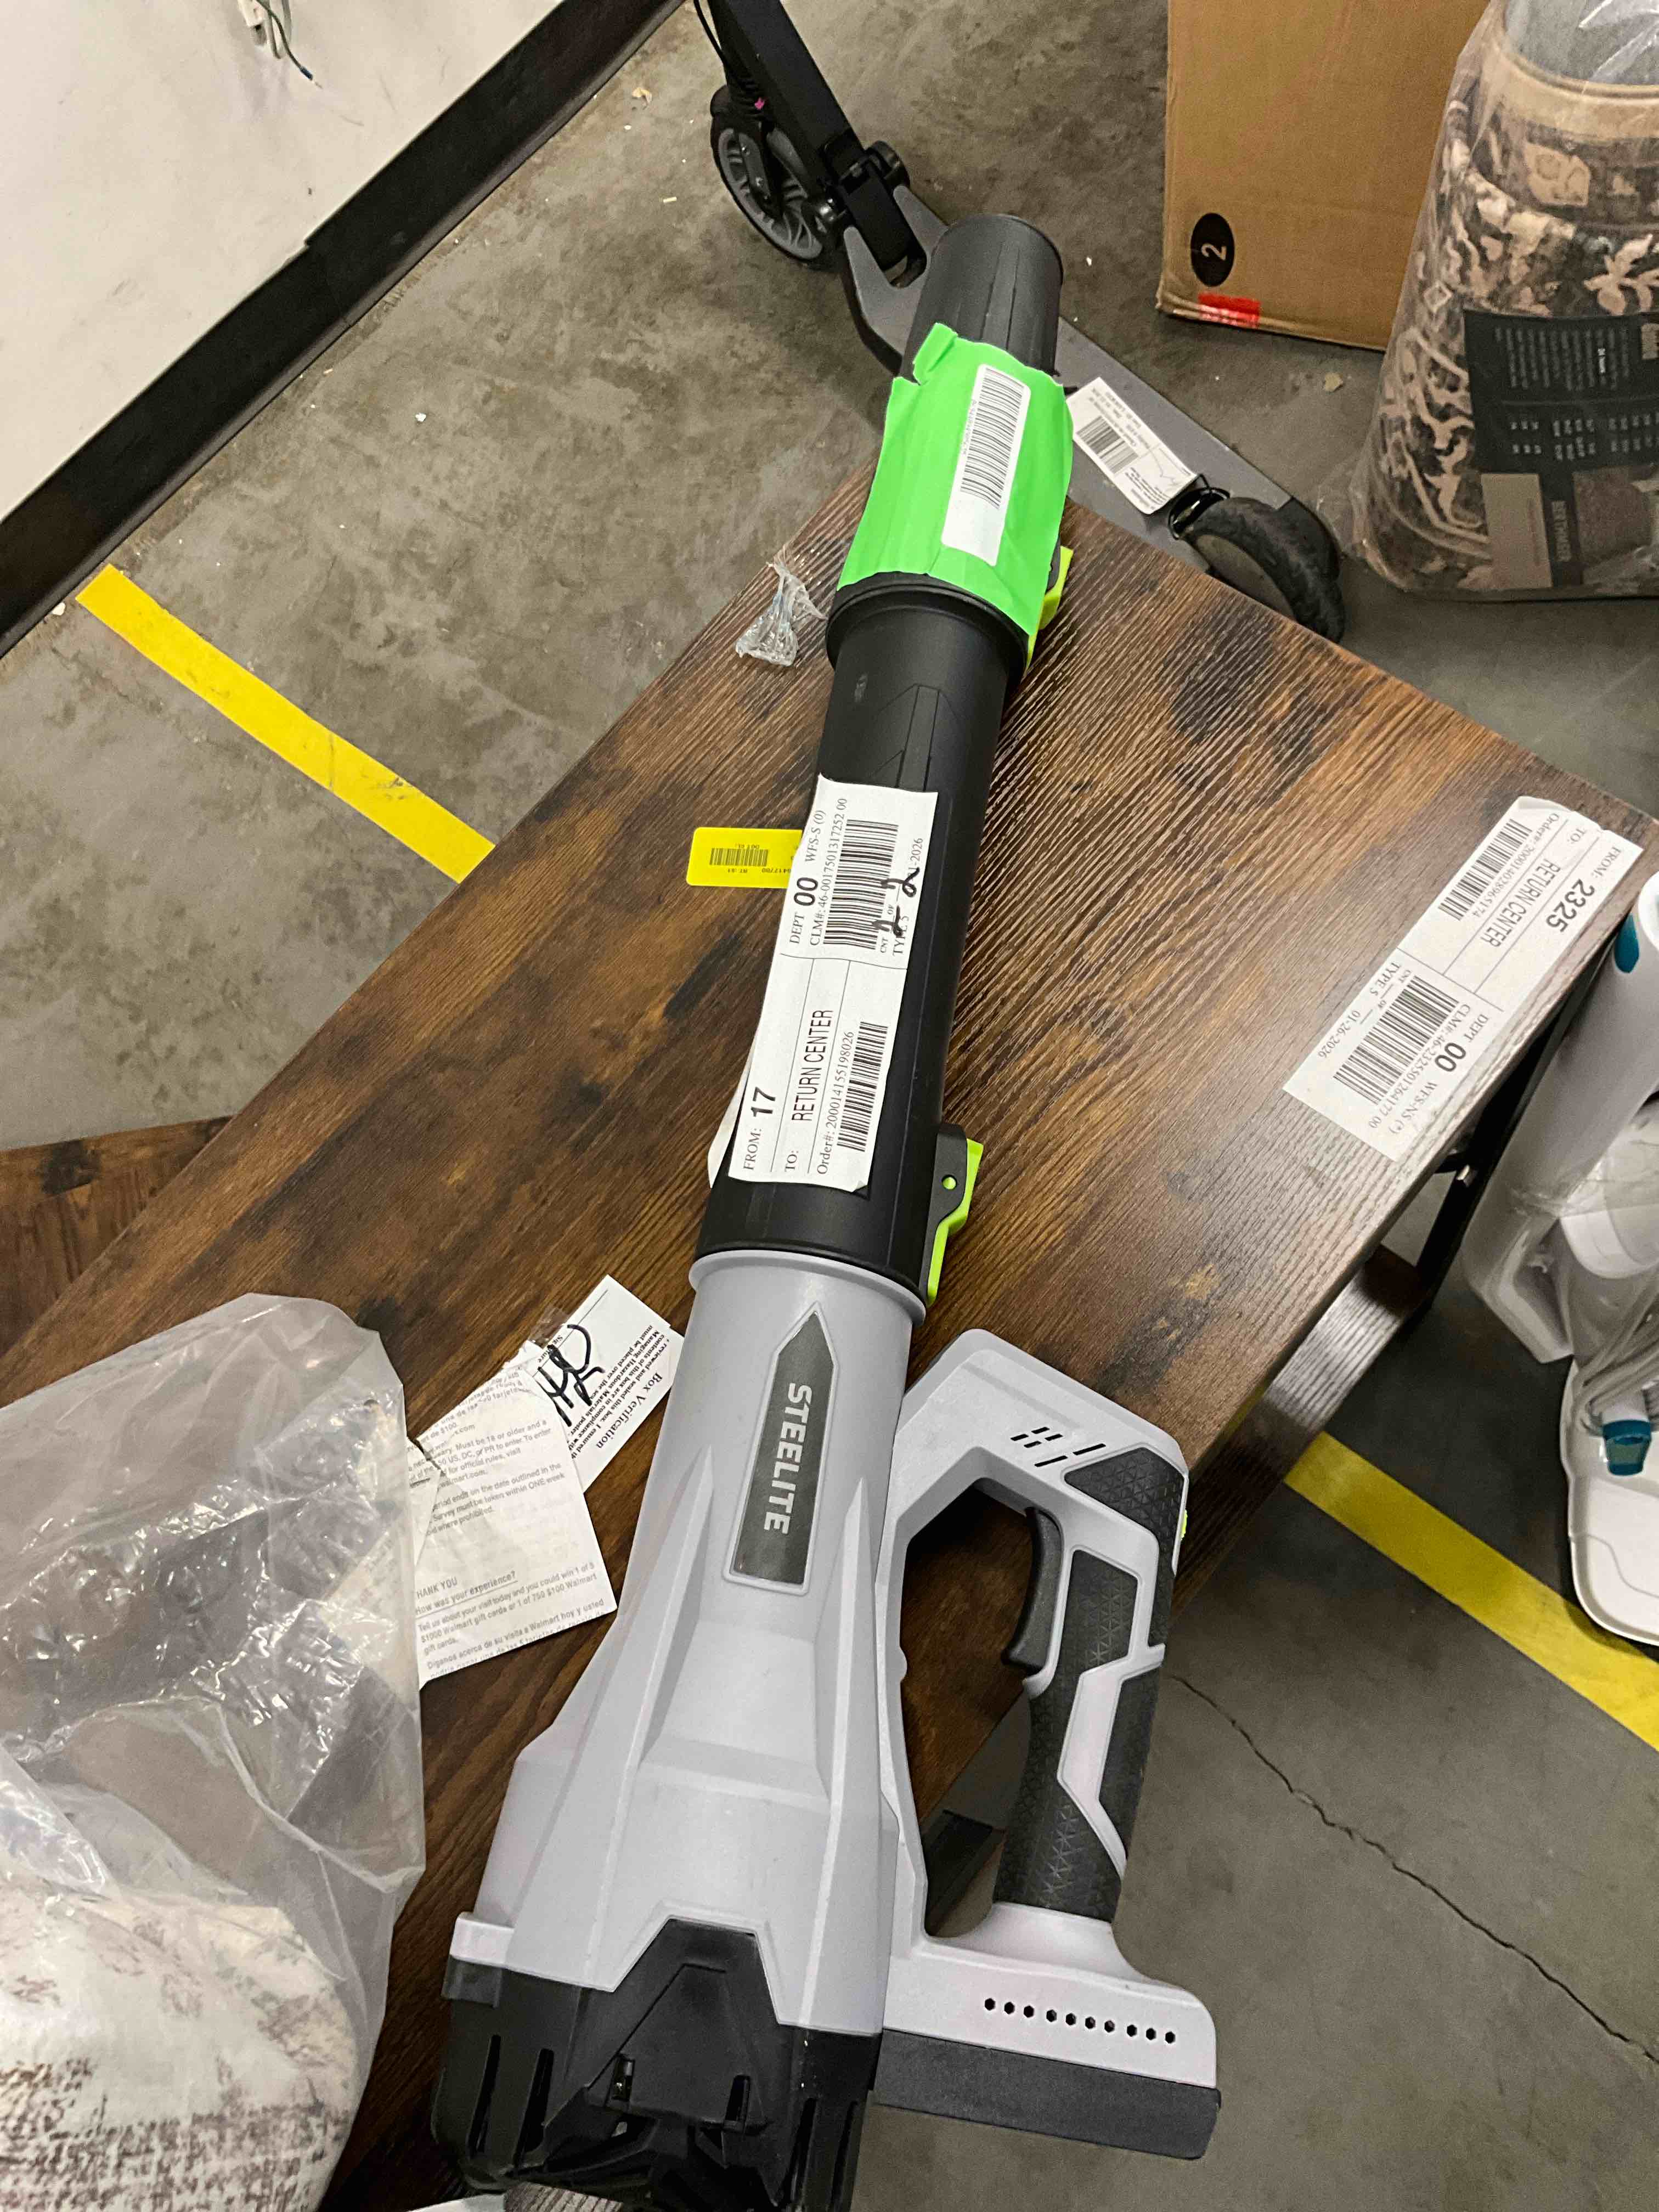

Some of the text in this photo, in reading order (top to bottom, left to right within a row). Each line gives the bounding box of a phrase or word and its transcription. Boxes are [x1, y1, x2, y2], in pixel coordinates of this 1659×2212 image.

[1201, 243, 1227, 261] 2
[1528, 811, 1560, 847] Order#:
[789, 809, 826, 944] DEPT 00 WFS-S (0)
[810, 797, 847, 946] CLM#: 46-0017501317252 00
[1479, 825, 1586, 951] TO: RETURN CENTER
[1543, 845, 1621, 935] FROM: 2325
[879, 904, 894, 953] CNT OF
[1374, 960, 1401, 989] TYPE
[1316, 1008, 1362, 1060] 01-26-2026
[1440, 1002, 1472, 1037] CLM#:
[1462, 1012, 1489, 1042] DEPT
[1432, 1038, 1469, 1076] 00
[784, 1007, 833, 1173] TO: RETURN CENTER
[816, 1030, 855, 1175] Order#: 200014155198026
[1398, 1077, 1438, 1122] WFS-NS
[743, 1086, 777, 1171] FROM: 17
[1367, 1114, 1383, 1130] 00
[632, 1328, 661, 1359] Managing
[632, 1340, 641, 1349] be
[639, 1324, 654, 1341] must
[642, 1334, 666, 1359] contents
[536, 1334, 563, 1364] Sigture
[616, 1346, 635, 1367] placed
[637, 1358, 646, 1367] of
[644, 1342, 668, 1369] reviewed
[594, 1379, 608, 1393] the
[606, 1365, 619, 1380] over
[607, 1358, 636, 1390] Hazardous
[618, 1376, 631, 1389] box
[627, 1365, 640, 1379] this
[635, 1368, 646, 1381] and
[584, 1389, 611, 1418] Materials
[604, 1398, 613, 1406] in
[610, 1387, 621, 1400] are
[610, 1398, 622, 1411] this
[620, 1380, 637, 1399] sealed
[576, 1404, 607, 1438] compliance
[594, 1372, 663, 1451] Box Verification
[600, 1410, 612, 1424] box.
[455, 1438, 476, 1451] Must
[475, 1436, 485, 1445] be
[486, 1434, 495, 1442] 18
[506, 1425, 526, 1437] older
[526, 1420, 541, 1430] and
[533, 1428, 552, 1439] enter
[575, 1427, 598, 1453] ensured
[460, 1458, 484, 1471] official
[505, 1446, 521, 1457] visit
[763, 1382, 813, 1534] STEELITE
[451, 1491, 469, 1503] ends
[481, 1483, 493, 1493] the
[493, 1479, 510, 1489] date
[510, 1468, 540, 1484] outlined
[549, 1462, 562, 1471] the
[455, 1500, 474, 1512] must
[484, 1491, 504, 1503] taken
[504, 1483, 528, 1497] within
[528, 1478, 546, 1489] ONE
[545, 1471, 566, 1484] week
[415, 1601, 435, 1615] How
[449, 1589, 469, 1604] your
[467, 1570, 518, 1596] experience?
[441, 1577, 458, 1590] YOU
[459, 1605, 478, 1619] your
[490, 1591, 514, 1607] today
[511, 1586, 526, 1597] and
[524, 1581, 541, 1595] you
[539, 1573, 560, 1587] could
[560, 1568, 574, 1579] win
[579, 1562, 589, 1572] of
[442, 1617, 473, 1635] Walmart
[472, 1612, 488, 1626] gift
[486, 1605, 508, 1619] cards
[521, 1595, 532, 1605] of
[565, 1571, 598, 1590] Walmart
[483, 1639, 493, 1649] de
[528, 1613, 561, 1632] Walmart
[560, 1608, 576, 1622] hoy
[582, 1596, 605, 1612] usted
[422, 1643, 437, 1656] gift
